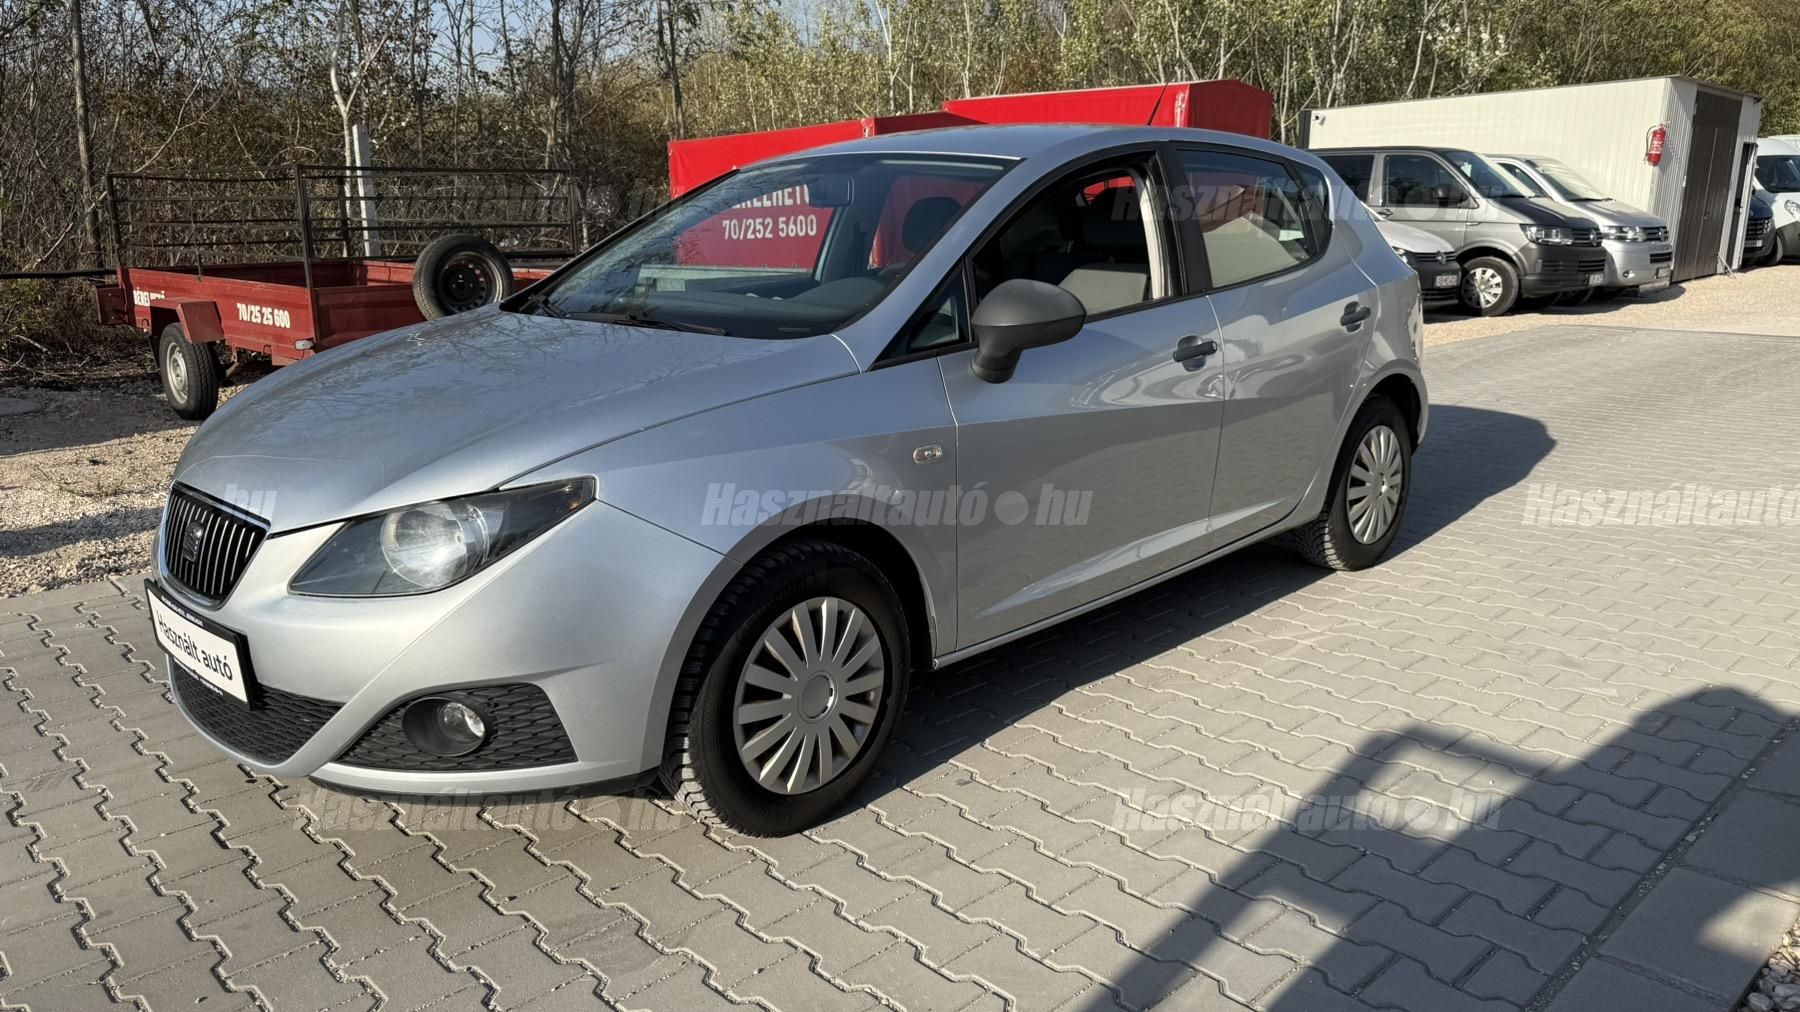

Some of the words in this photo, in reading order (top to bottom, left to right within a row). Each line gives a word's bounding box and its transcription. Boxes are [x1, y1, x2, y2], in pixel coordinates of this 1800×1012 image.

[722, 217, 773, 240] 70/252
[778, 214, 817, 238] 5600
[237, 302, 261, 324] 70/25
[262, 307, 273, 326] 25
[274, 308, 290, 329] 600
[156, 610, 201, 664] Használt
[201, 649, 234, 682] autó
